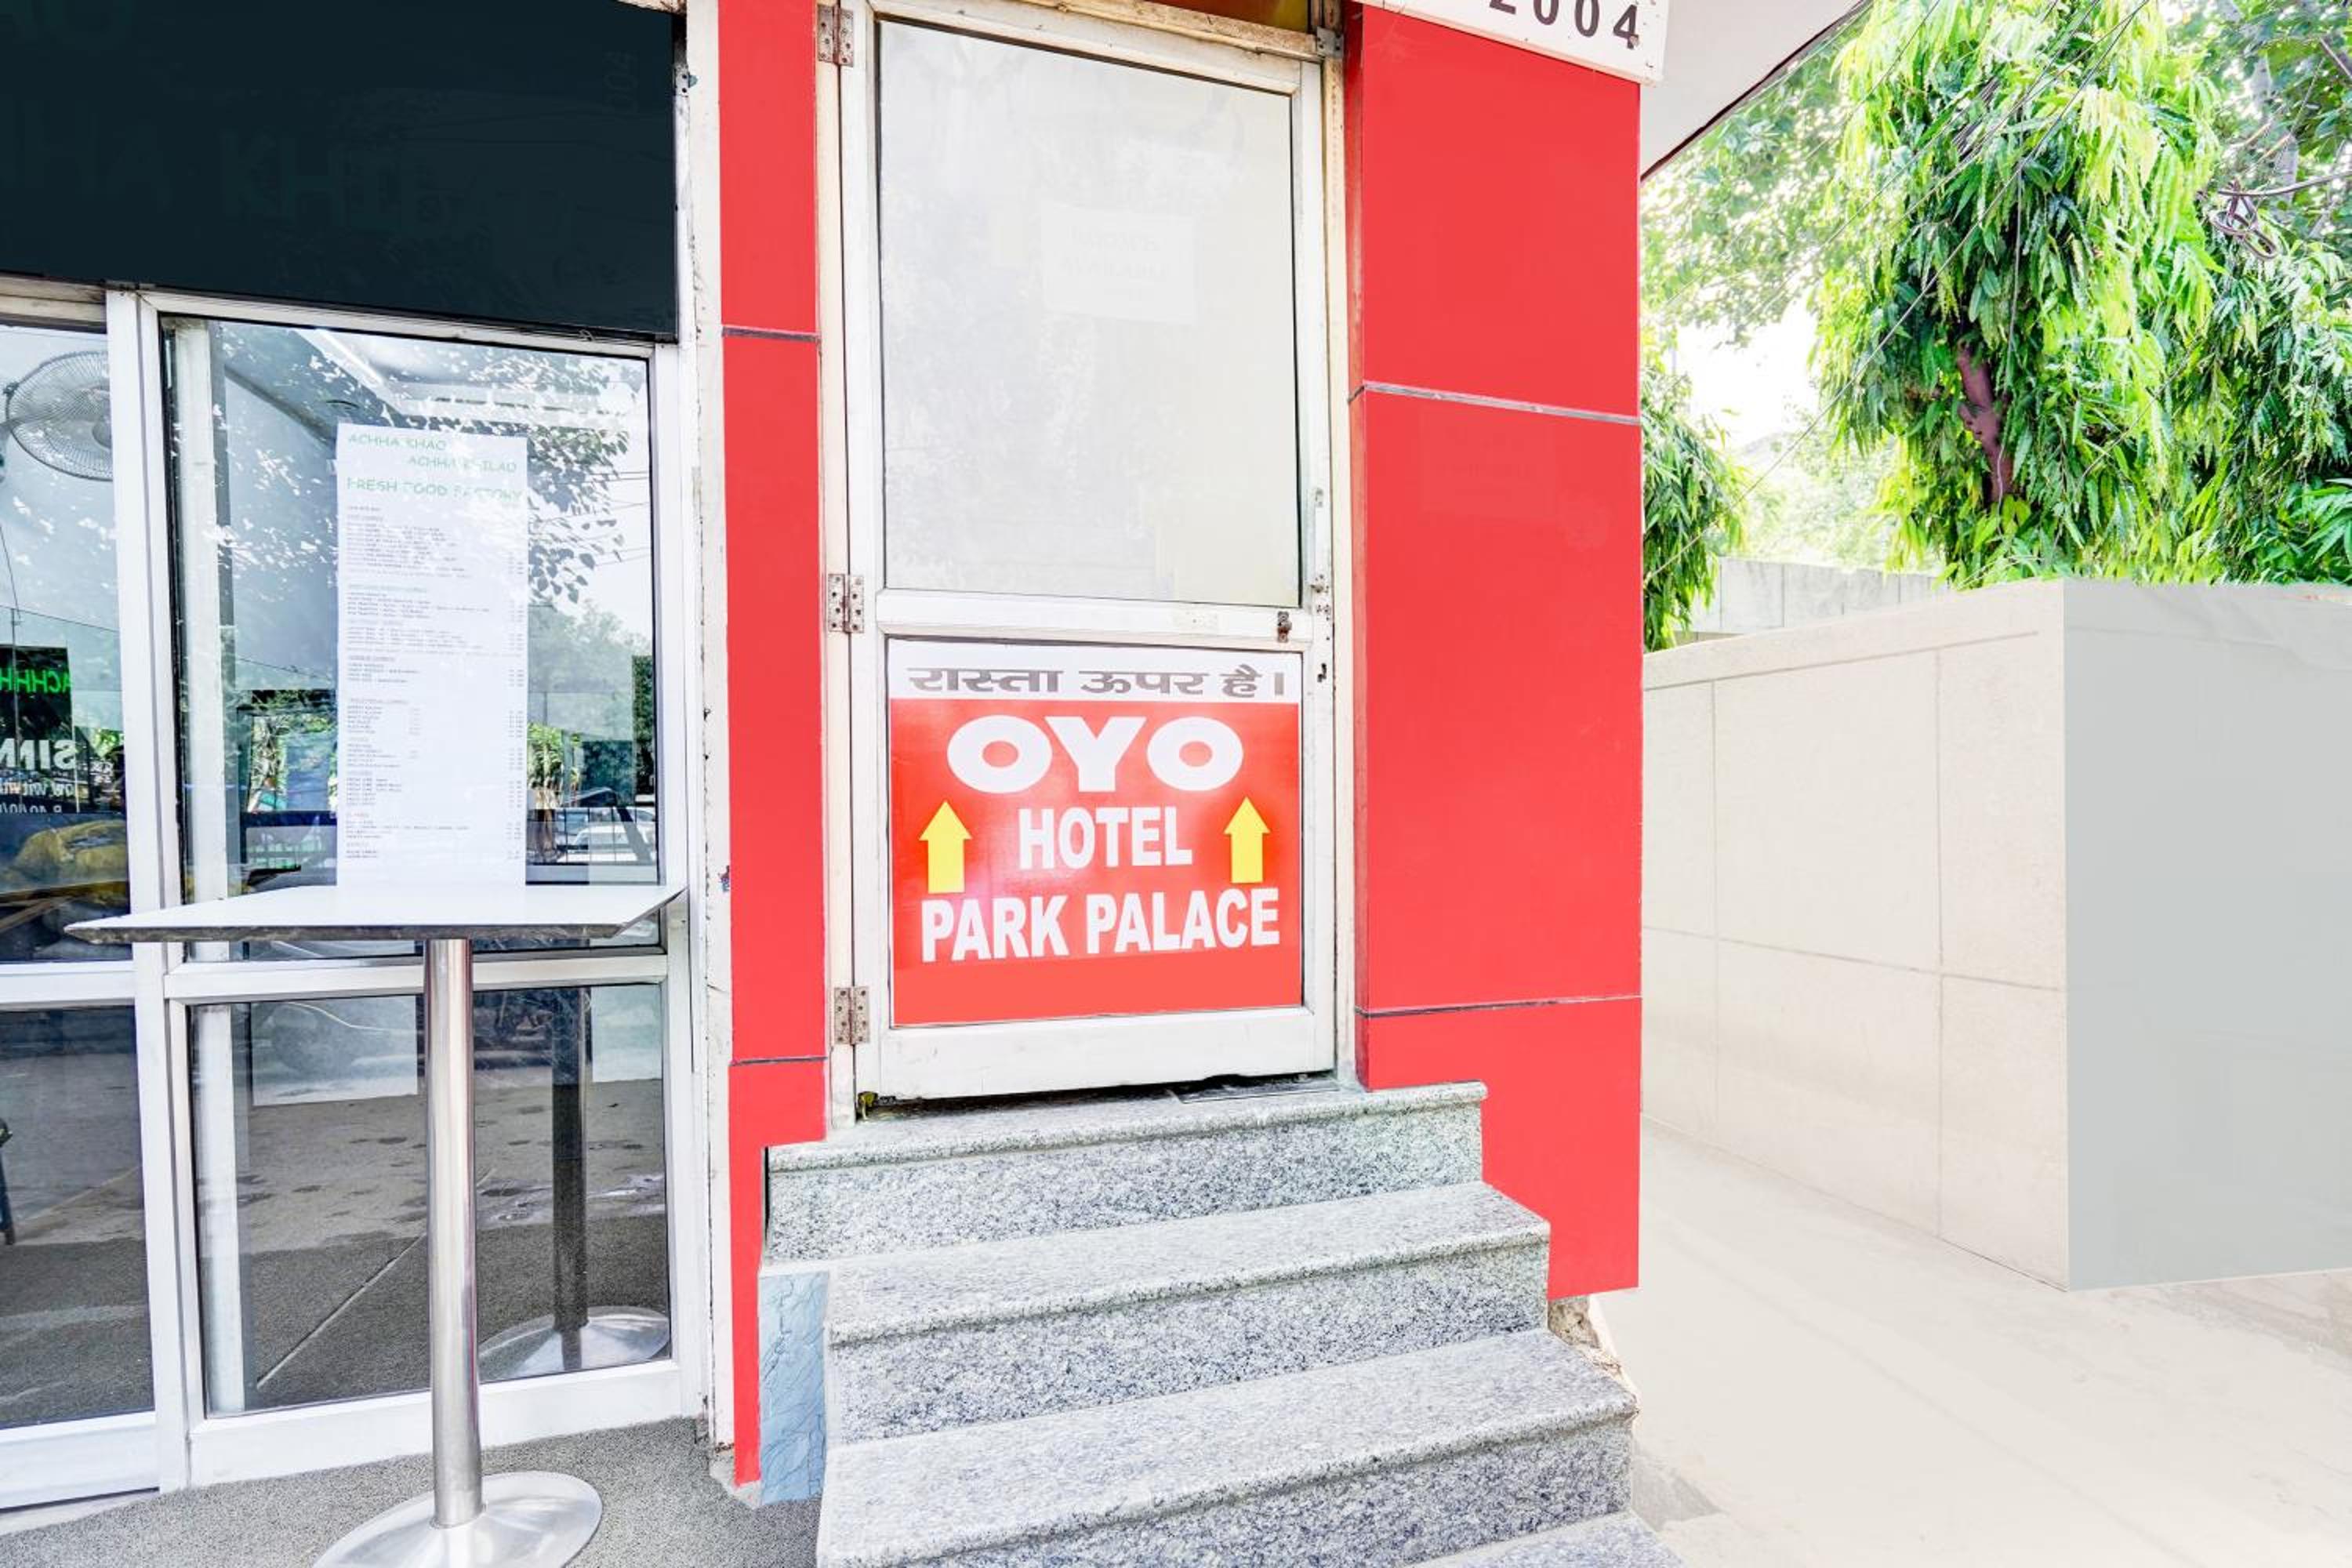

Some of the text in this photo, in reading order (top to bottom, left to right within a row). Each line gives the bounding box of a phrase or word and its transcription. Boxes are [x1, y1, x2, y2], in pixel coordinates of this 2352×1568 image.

[347, 477, 397, 492] FRESH
[907, 668, 1063, 692] रास्ता
[1080, 670, 1208, 696] ऊपर
[947, 715, 1244, 793] OYO
[1018, 806, 1192, 870] HOTEL
[921, 888, 1279, 962] PARK PALACE
